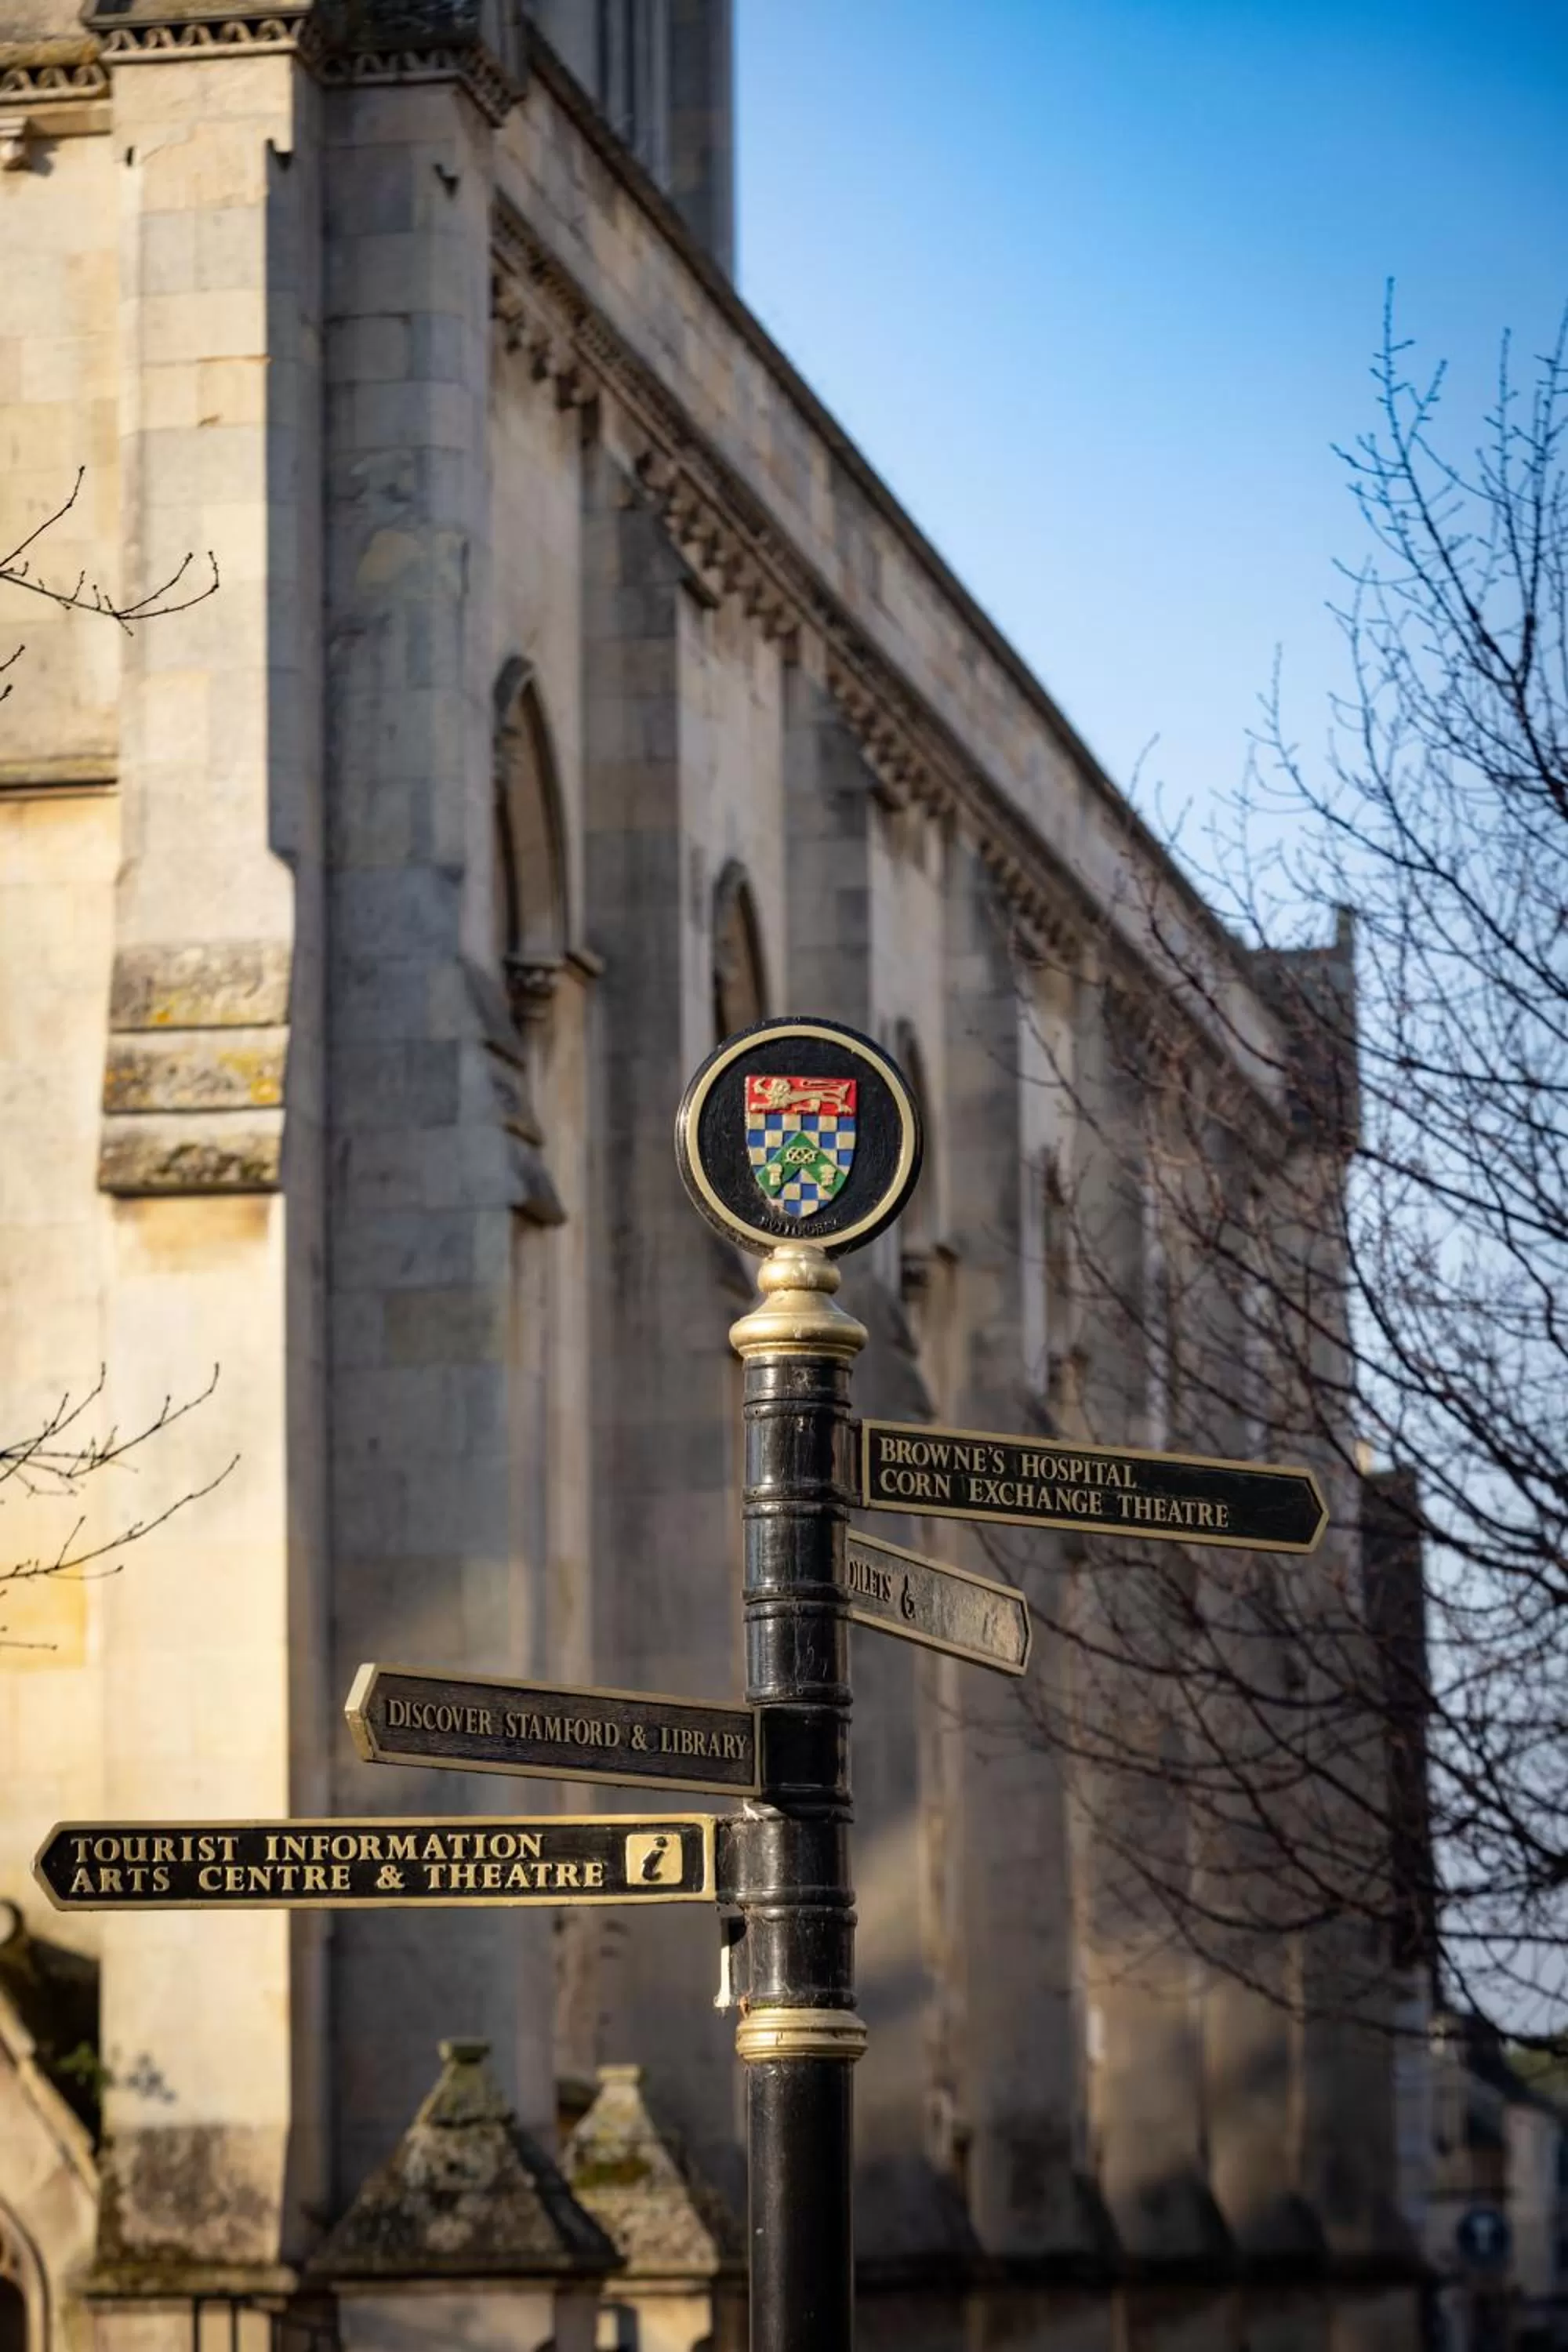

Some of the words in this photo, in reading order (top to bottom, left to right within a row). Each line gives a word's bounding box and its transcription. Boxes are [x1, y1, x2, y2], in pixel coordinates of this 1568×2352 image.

[879, 1436, 1005, 1473] BROWNE'S
[1021, 1454, 1137, 1489] HOSPITAL
[879, 1469, 951, 1499] CORN
[969, 1478, 1102, 1515] EXCHANGE
[1117, 1495, 1229, 1529] THEATRE
[846, 1560, 892, 1602] OILETS
[388, 1699, 492, 1735] DISCOVER
[506, 1713, 620, 1748] STAMFORD
[630, 1726, 648, 1751] &
[661, 1727, 747, 1760] LIBRARY
[71, 1836, 239, 1863] TOURIST
[266, 1833, 543, 1861] INFORMATION
[71, 1867, 170, 1893] ARTS
[198, 1866, 350, 1892] CENTRE
[376, 1864, 405, 1889] &
[423, 1863, 604, 1889] THEATRE
